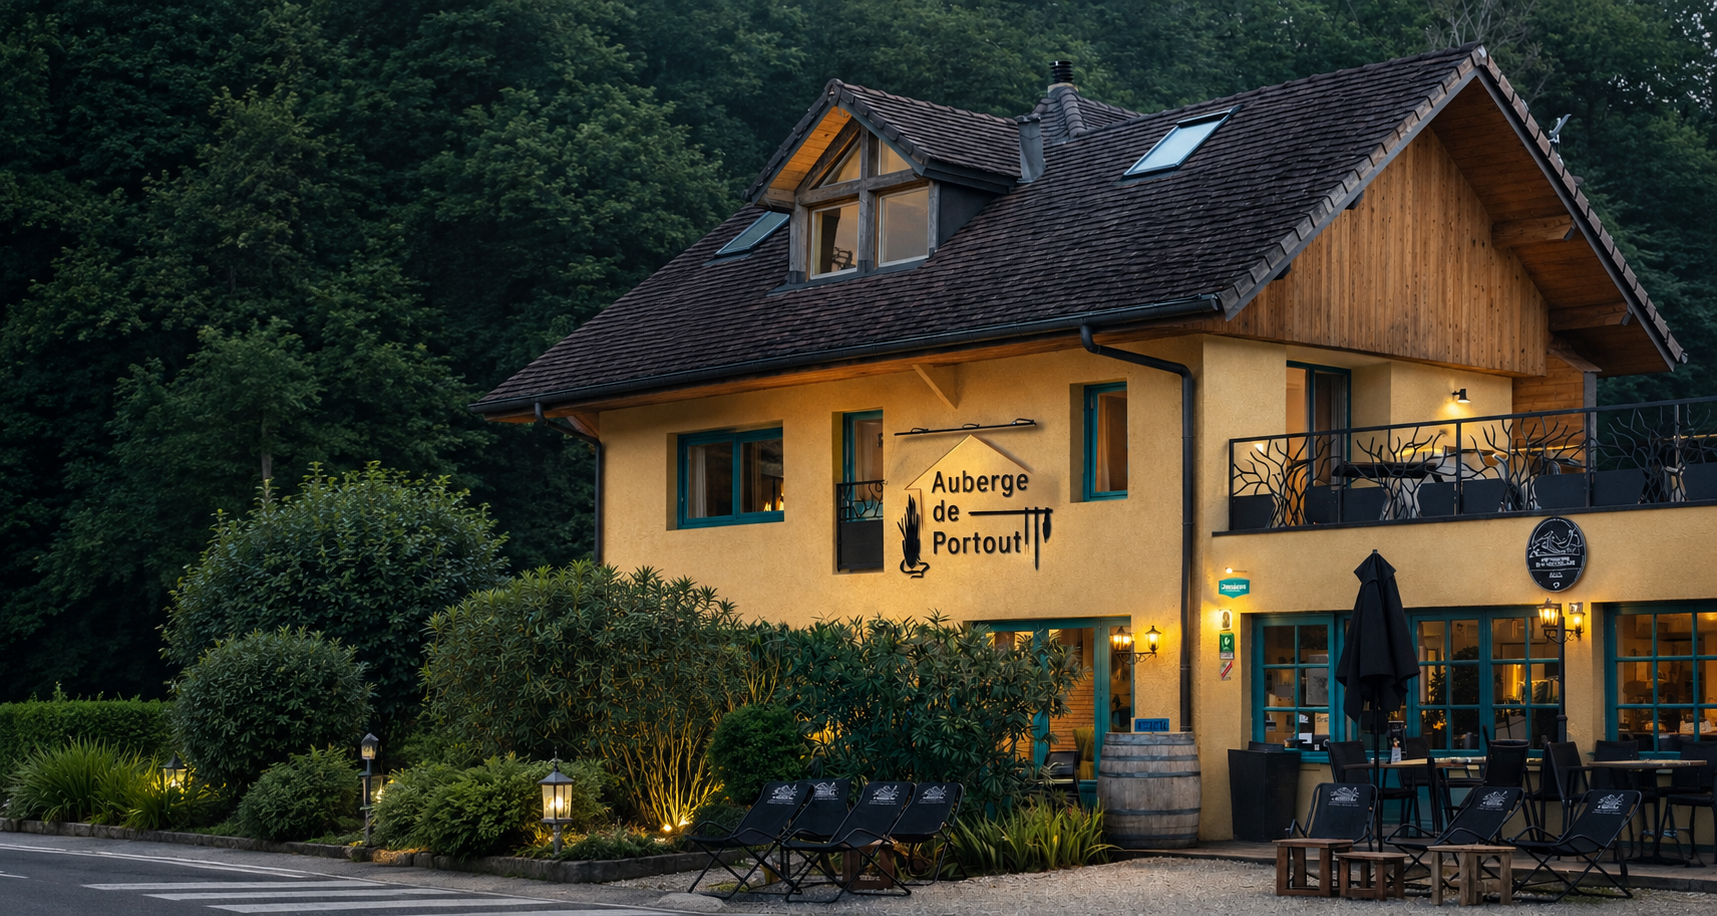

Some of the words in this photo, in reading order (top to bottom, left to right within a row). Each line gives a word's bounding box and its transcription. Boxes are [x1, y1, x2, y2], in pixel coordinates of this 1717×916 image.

[931, 470, 1029, 498] Auberge
[933, 499, 960, 522] de
[933, 531, 1022, 555] Portout
